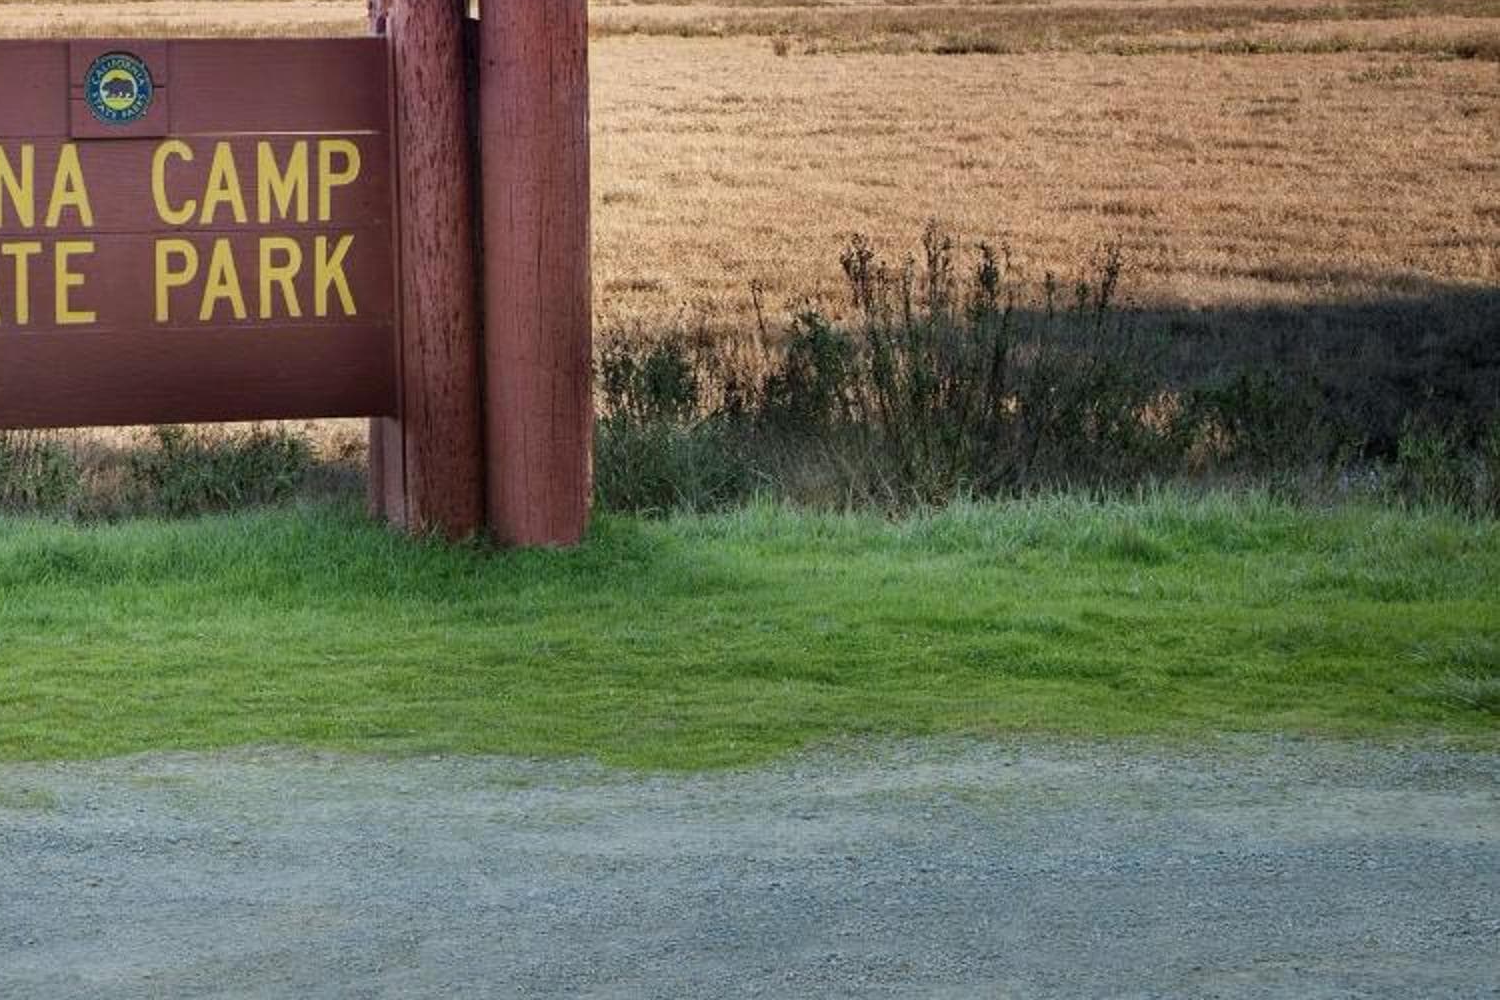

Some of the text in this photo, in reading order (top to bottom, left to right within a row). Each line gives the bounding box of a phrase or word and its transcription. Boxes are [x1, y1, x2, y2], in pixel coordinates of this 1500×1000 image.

[90, 58, 146, 85] CALIFORNIA
[90, 91, 117, 119] STATE
[151, 139, 361, 225] CAMP
[155, 234, 357, 321] PARK
